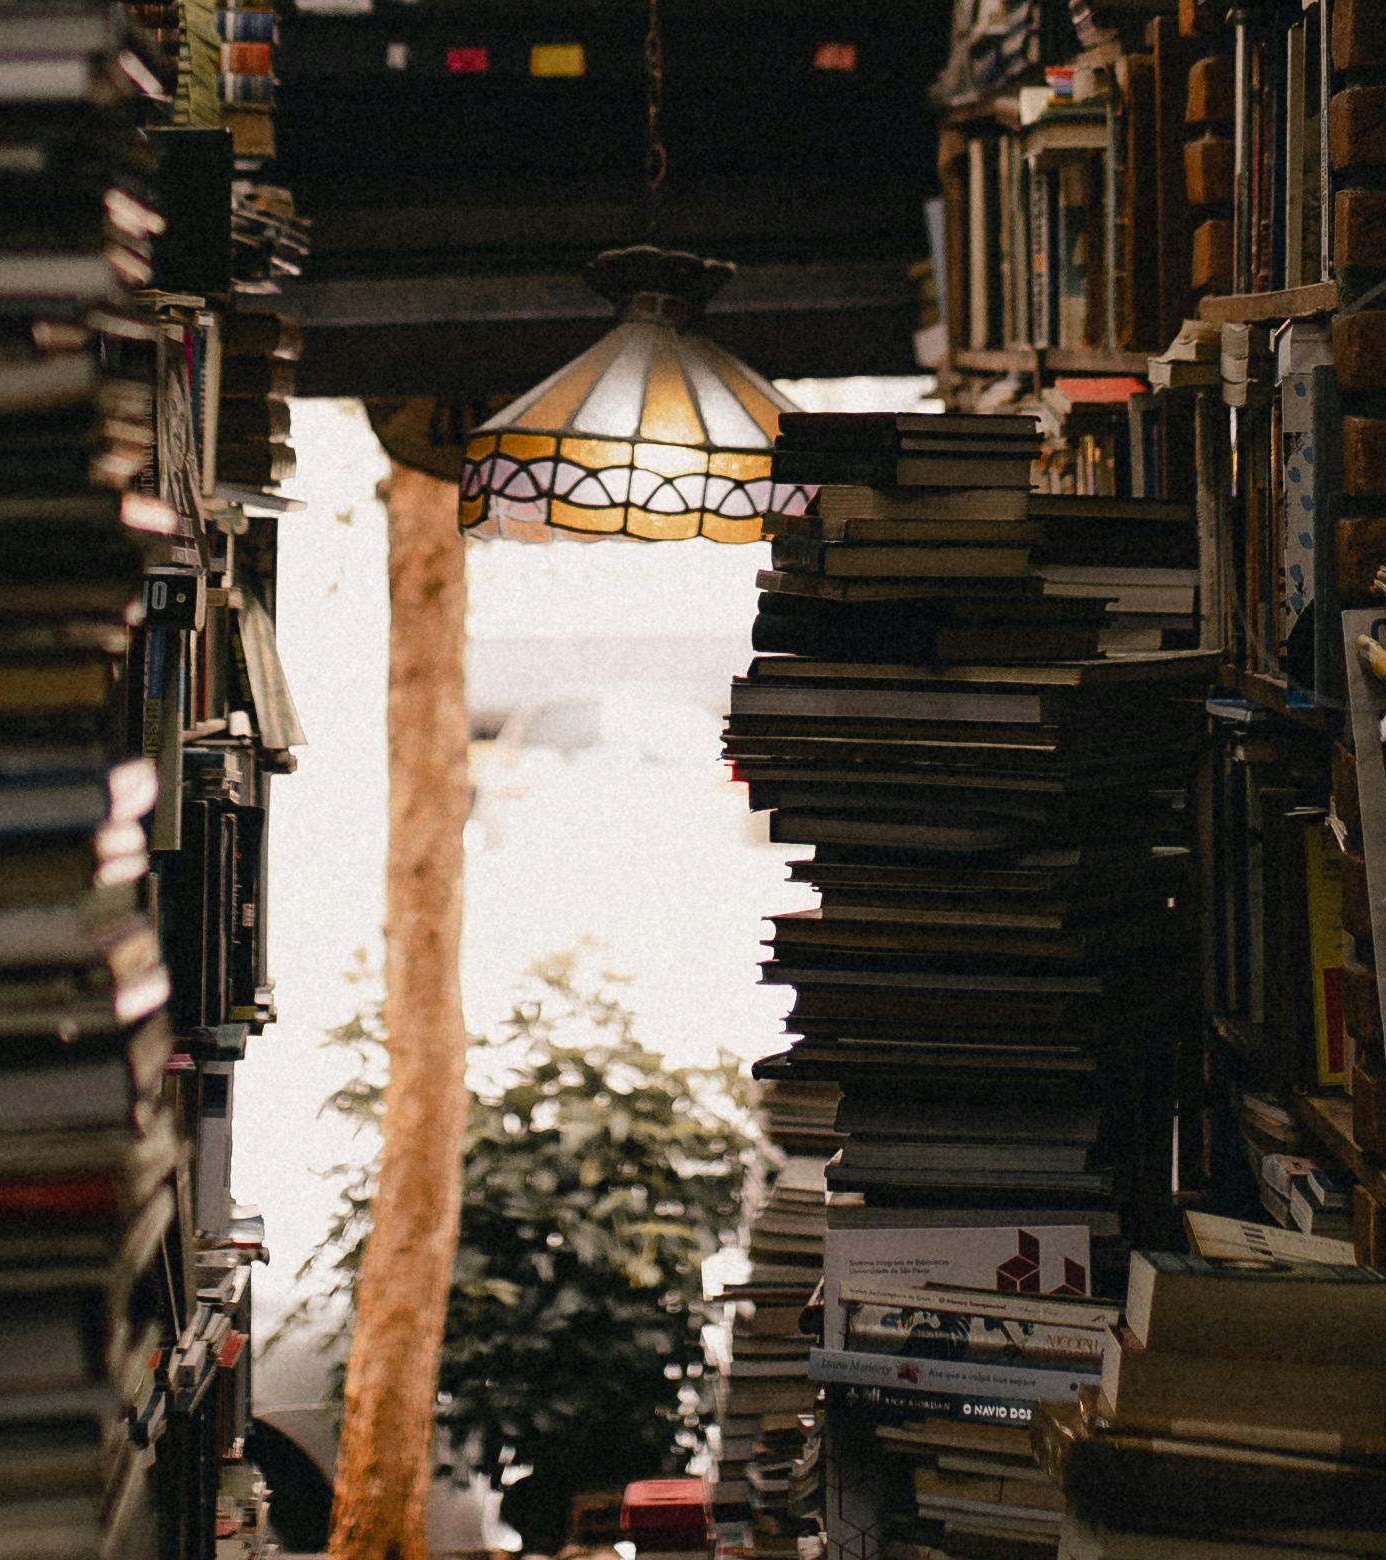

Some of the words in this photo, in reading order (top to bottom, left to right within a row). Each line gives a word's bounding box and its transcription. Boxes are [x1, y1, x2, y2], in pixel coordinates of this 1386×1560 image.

[849, 1359, 892, 1376] Moriarty
[963, 1403, 971, 1416] O
[974, 1405, 1007, 1419] NAVIO
[1010, 1407, 1033, 1421] DOS
